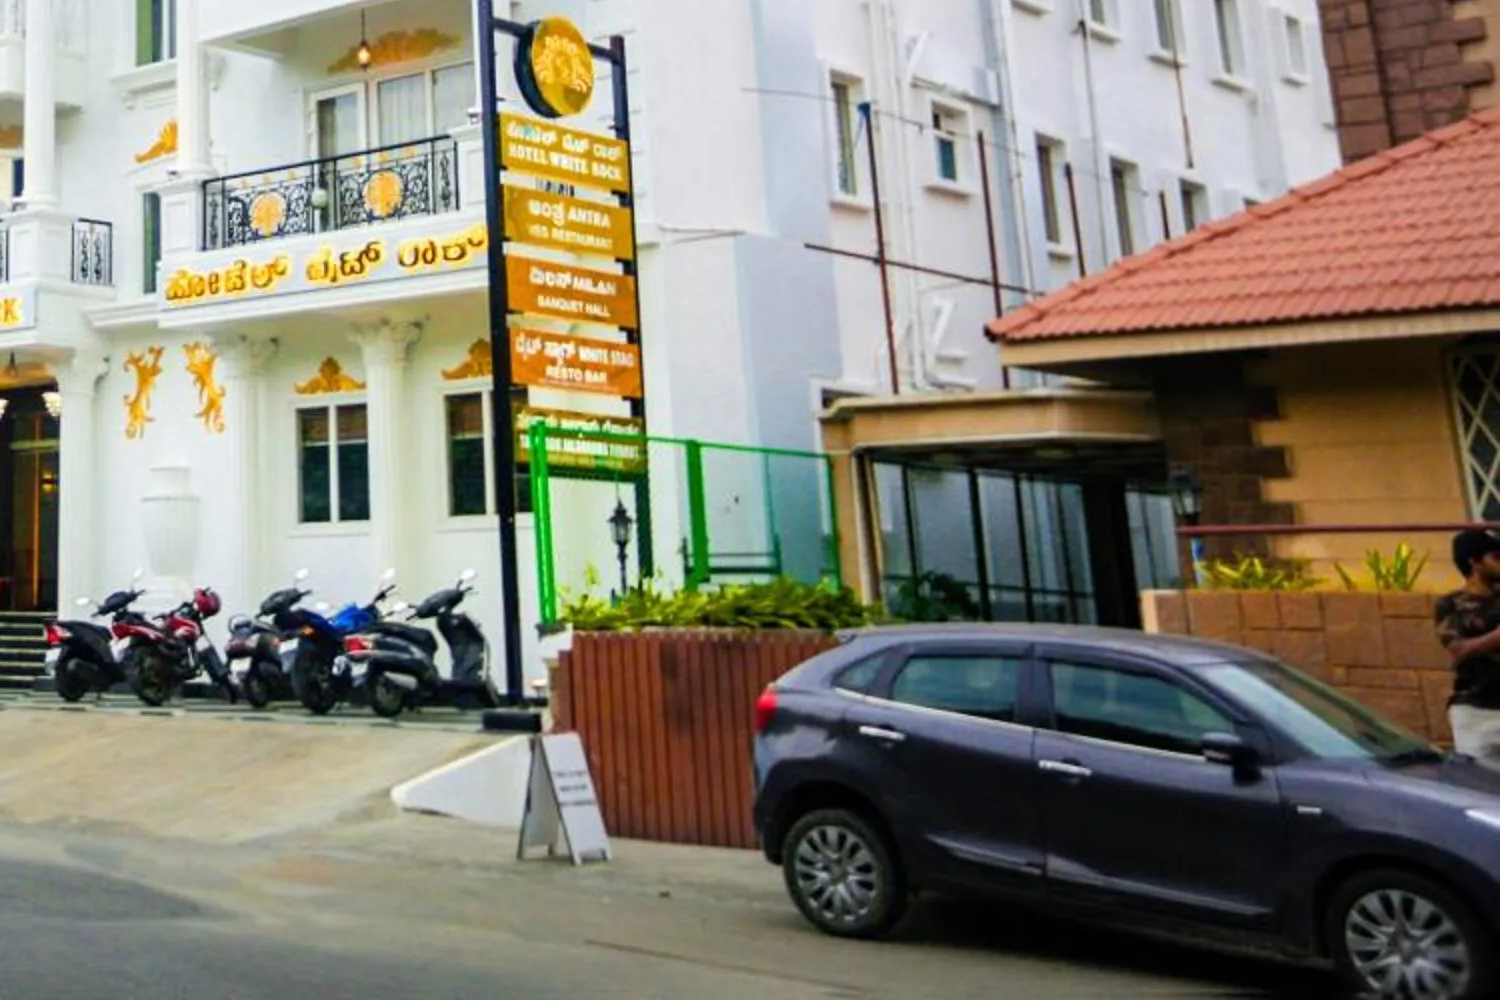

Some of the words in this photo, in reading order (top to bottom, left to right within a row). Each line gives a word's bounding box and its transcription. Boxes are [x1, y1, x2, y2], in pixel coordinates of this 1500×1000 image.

[508, 143, 548, 165] HOTEL
[550, 151, 589, 175] WHITE
[591, 161, 621, 181] ROCK
[567, 206, 611, 229] ANTRA
[572, 275, 617, 296] MILAN
[537, 294, 584, 313] BANQUET
[586, 303, 611, 318] HALL
